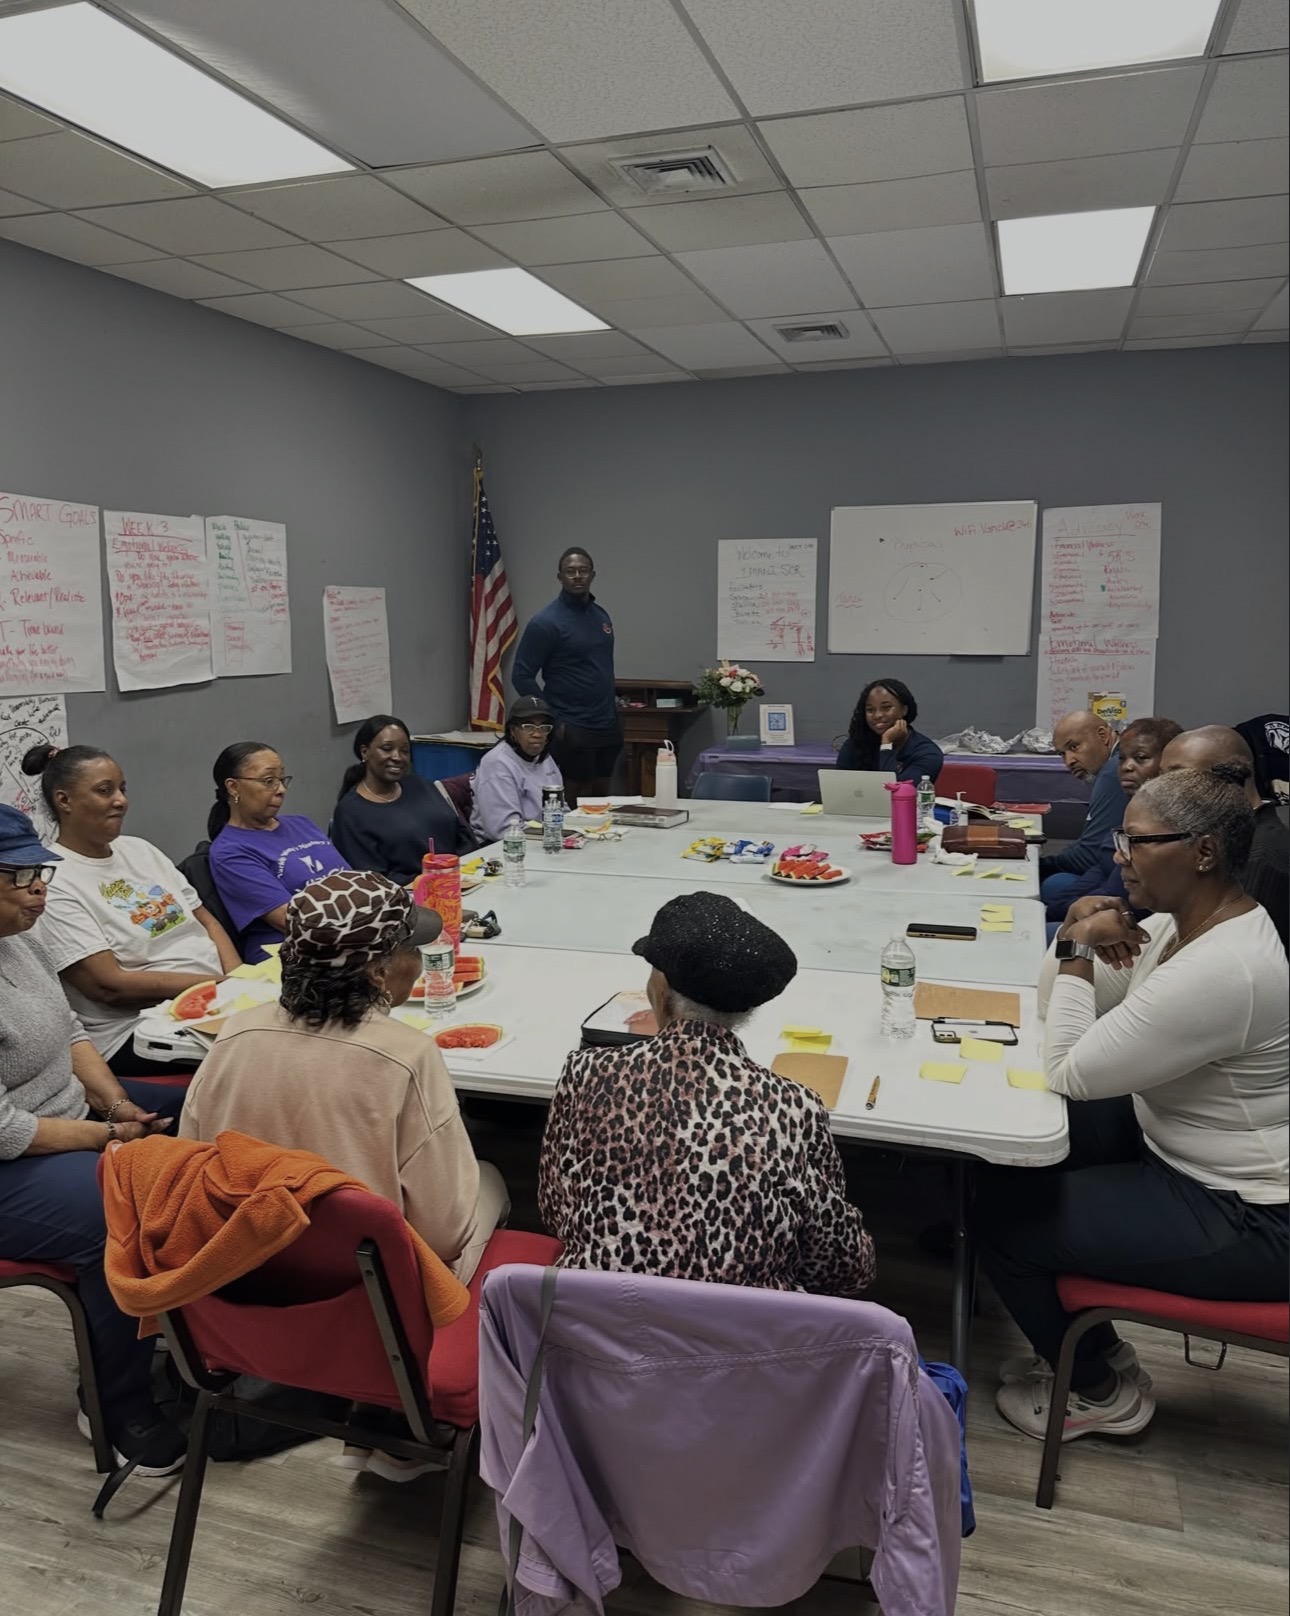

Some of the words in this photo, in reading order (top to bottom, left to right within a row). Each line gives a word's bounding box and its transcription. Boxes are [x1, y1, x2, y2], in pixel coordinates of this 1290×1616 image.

[0, 496, 53, 523] SMART
[59, 503, 97, 528] GOALS
[121, 516, 154, 536] WEEK
[161, 520, 169, 532] 3
[1049, 635, 1097, 650] Emotional
